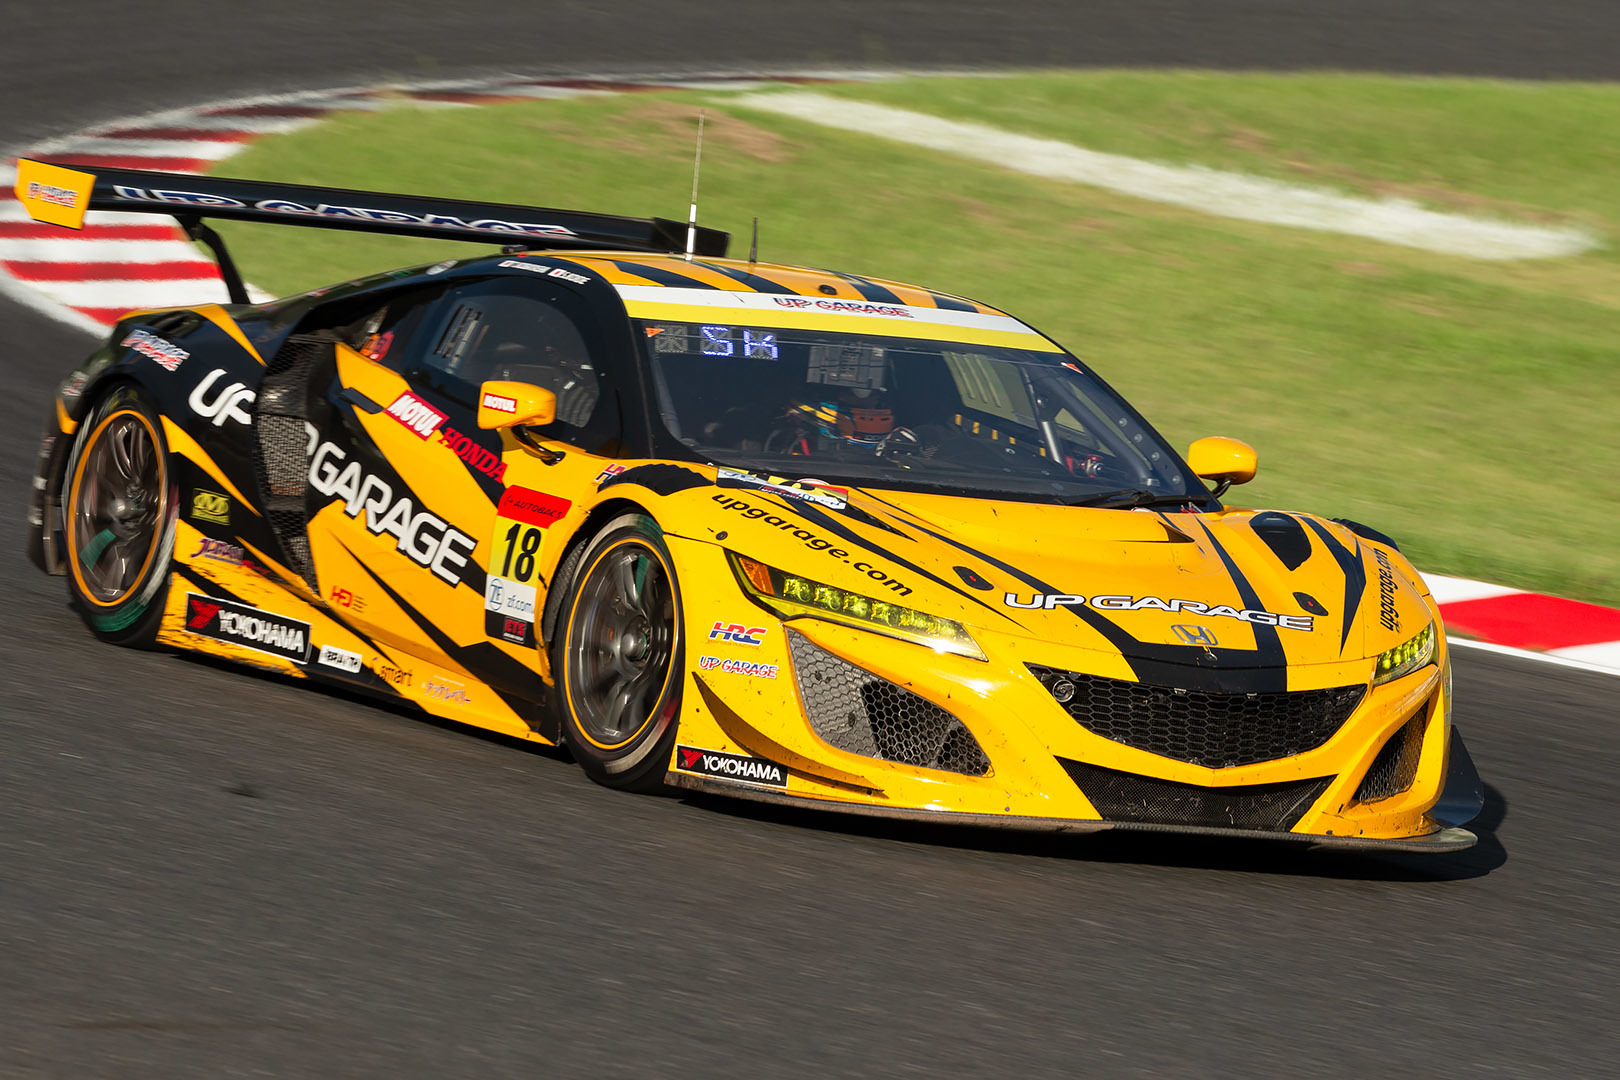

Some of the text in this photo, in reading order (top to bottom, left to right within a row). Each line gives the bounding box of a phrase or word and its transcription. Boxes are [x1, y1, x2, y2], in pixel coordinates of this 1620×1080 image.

[772, 297, 914, 319] UP GARAGE
[386, 394, 443, 437] MOTUL
[483, 394, 516, 412] MOTUL
[437, 427, 508, 484] HONDA
[308, 441, 478, 586] GARAGE
[513, 500, 563, 519] AUTOBACS
[501, 523, 542, 583] 18
[711, 493, 914, 598] upgarage.com
[1373, 547, 1400, 634] upgarage.com
[217, 608, 305, 653] YOKOHAMA
[504, 618, 526, 637] ETS
[1004, 592, 1315, 632] UP GARAGE
[708, 620, 768, 646] HRC
[699, 655, 780, 680] UP GARAGE
[702, 754, 782, 782] YOKOHAMA
